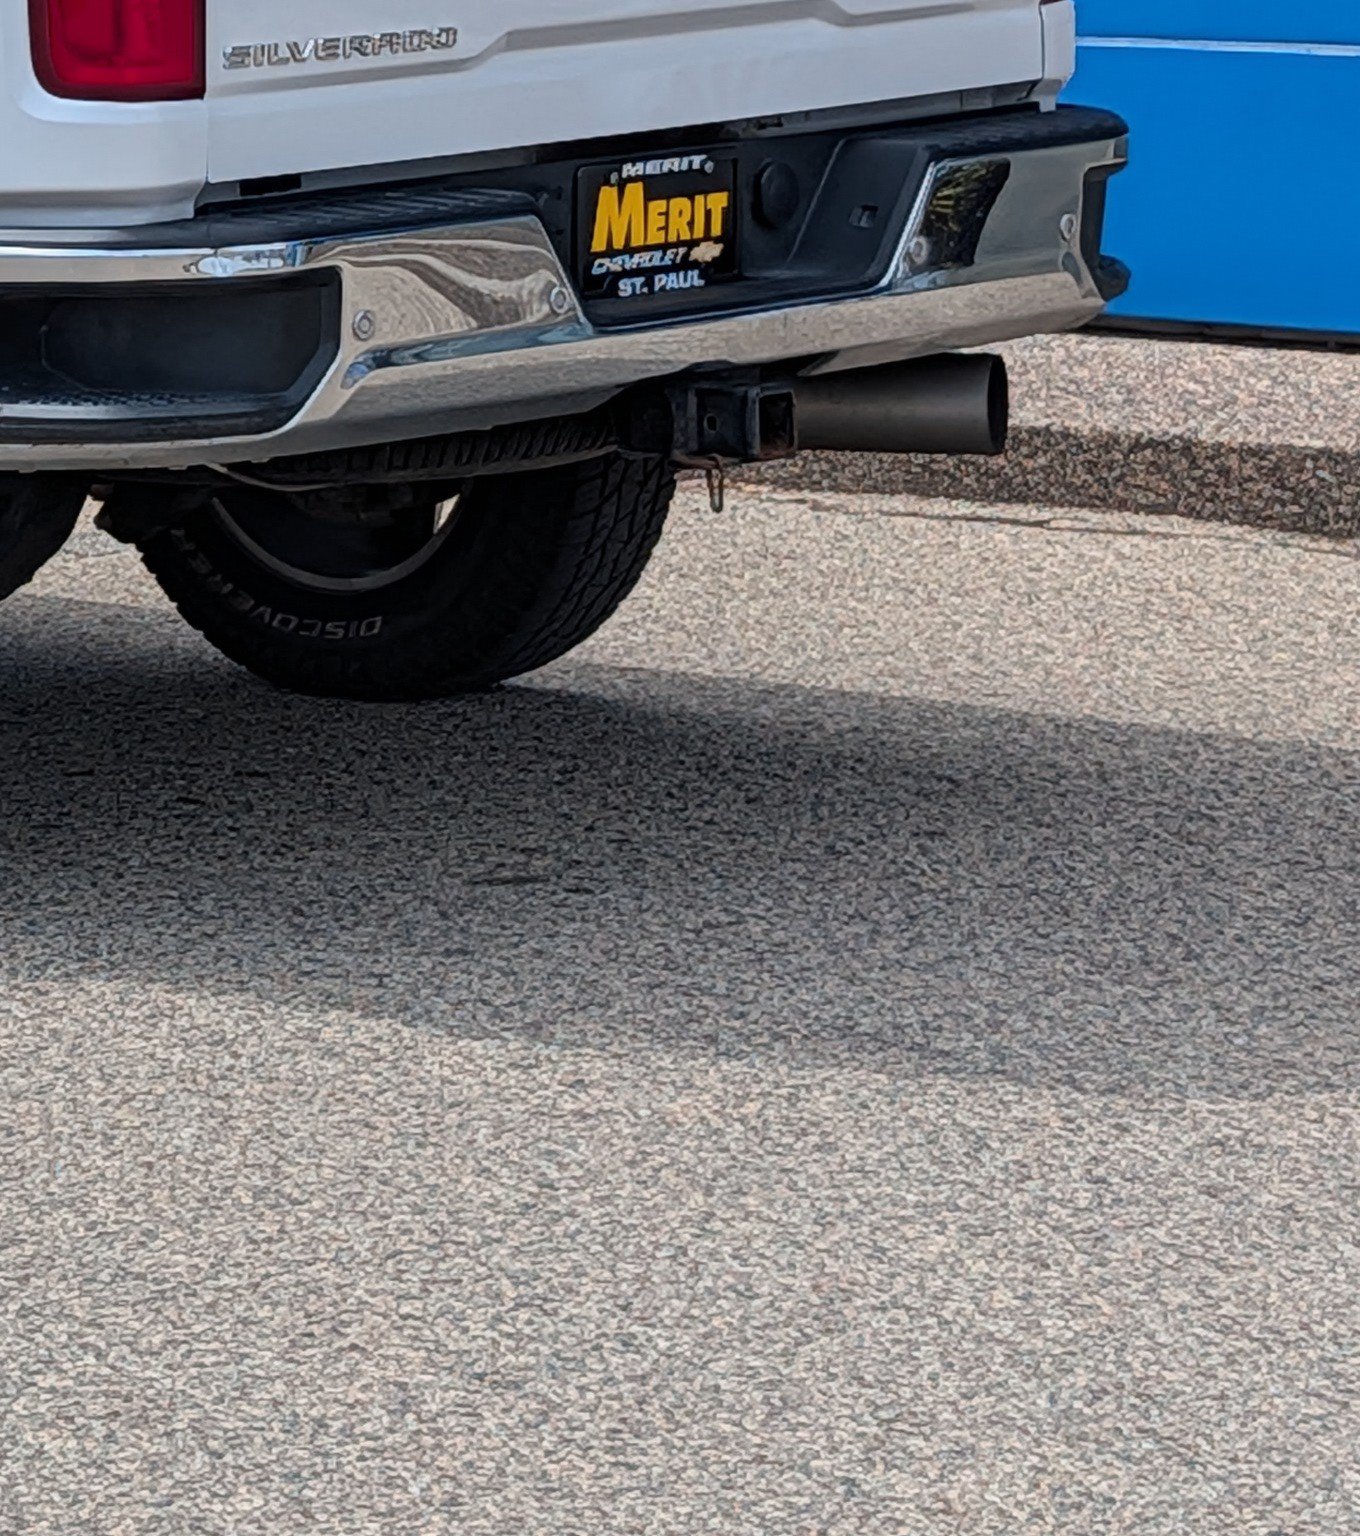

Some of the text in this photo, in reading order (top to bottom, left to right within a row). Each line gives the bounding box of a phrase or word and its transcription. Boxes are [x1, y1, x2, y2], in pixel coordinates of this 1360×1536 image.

[222, 26, 458, 70] SILVERADO
[621, 154, 708, 179] MERIT
[618, 269, 706, 298] ST. PAUL
